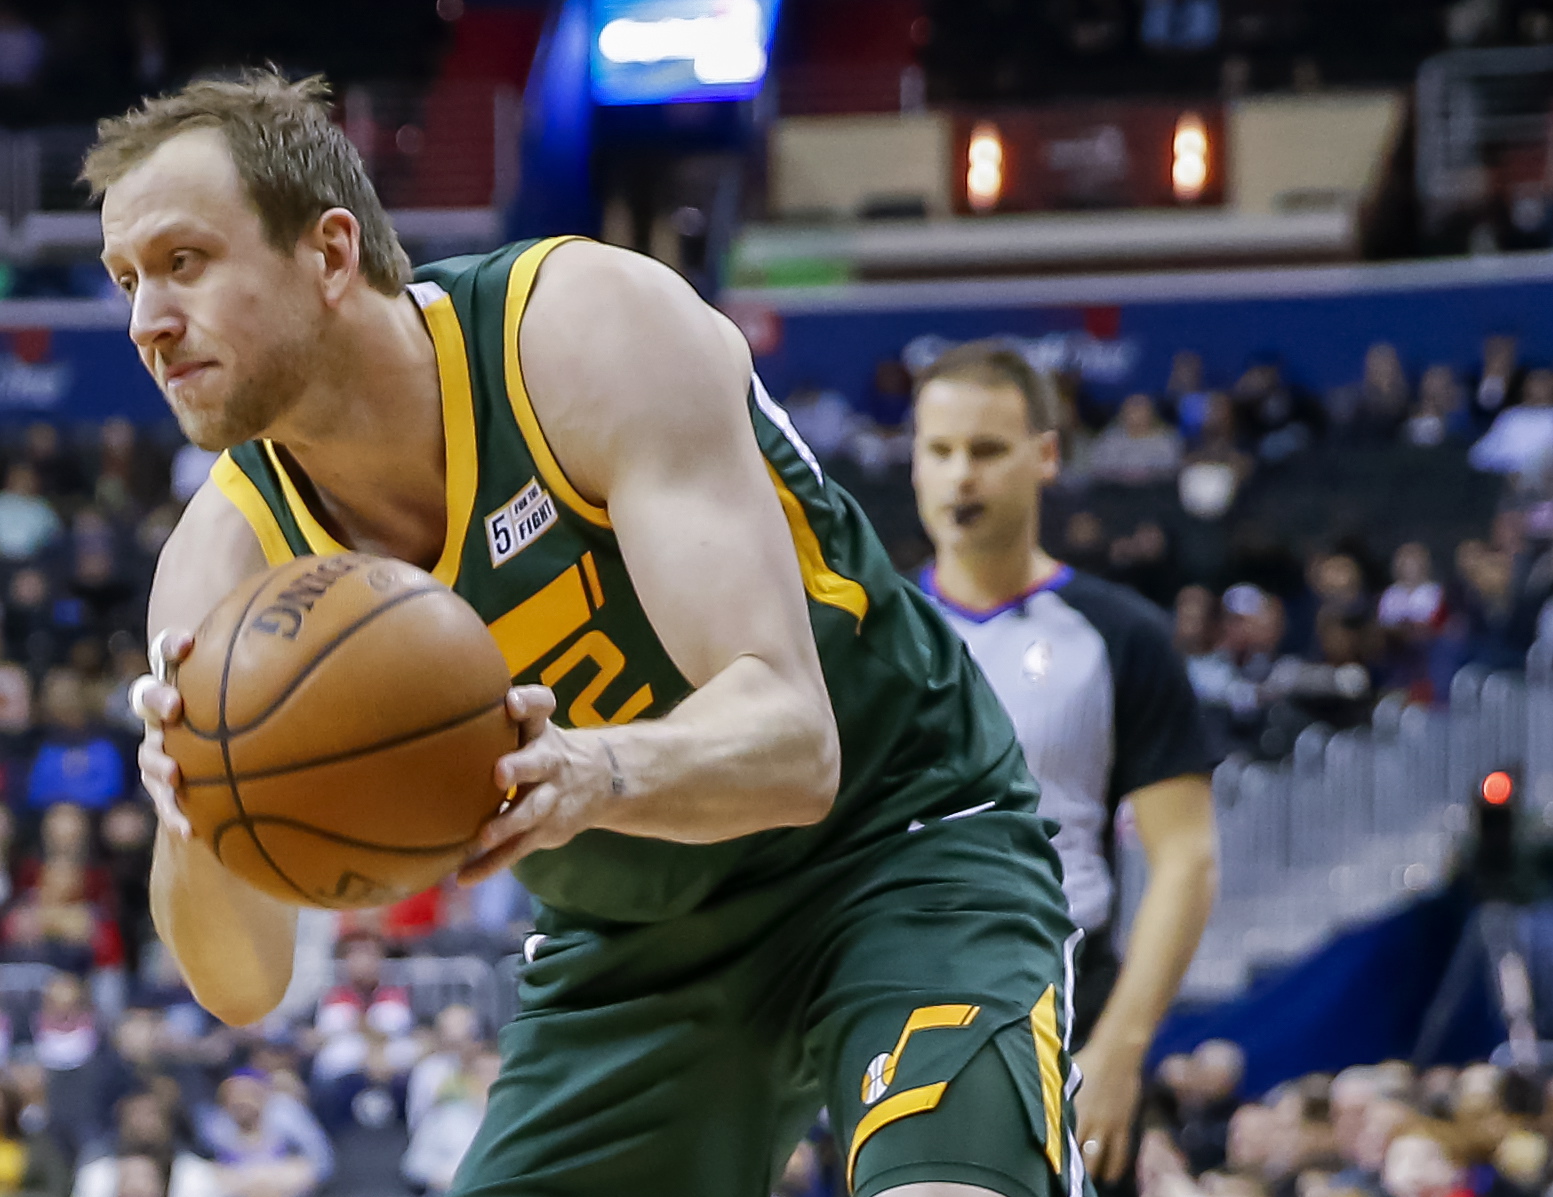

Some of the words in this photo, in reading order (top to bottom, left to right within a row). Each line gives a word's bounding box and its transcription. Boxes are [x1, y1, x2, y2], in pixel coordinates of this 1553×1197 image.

[492, 514, 511, 554] 5
[518, 499, 552, 540] FIGHT
[540, 629, 654, 729] 2
